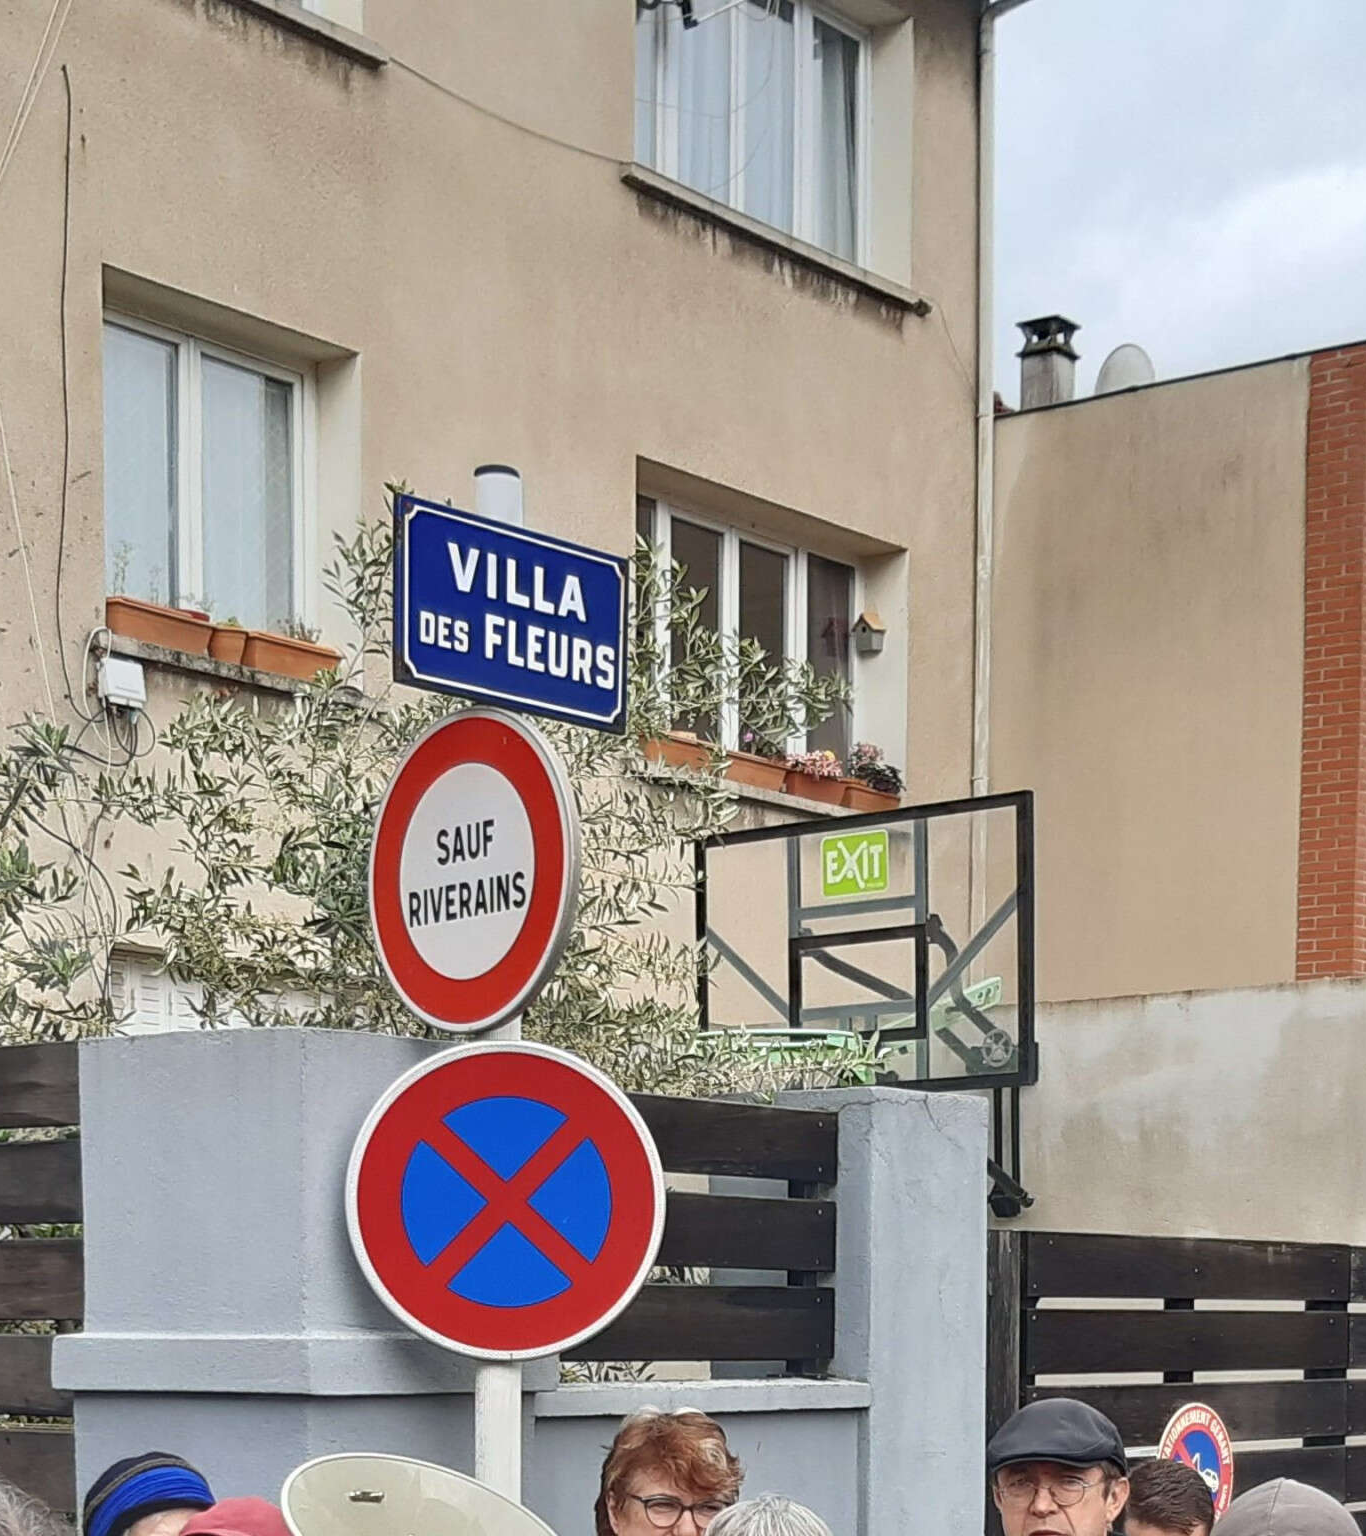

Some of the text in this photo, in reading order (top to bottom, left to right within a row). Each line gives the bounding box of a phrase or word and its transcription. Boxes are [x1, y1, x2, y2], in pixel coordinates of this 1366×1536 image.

[447, 541, 587, 623] VILLA
[419, 610, 616, 691] DES FLEURS
[436, 819, 495, 866] SAUF
[826, 840, 884, 889] EXIT
[408, 871, 527, 928] RIVERAINS
